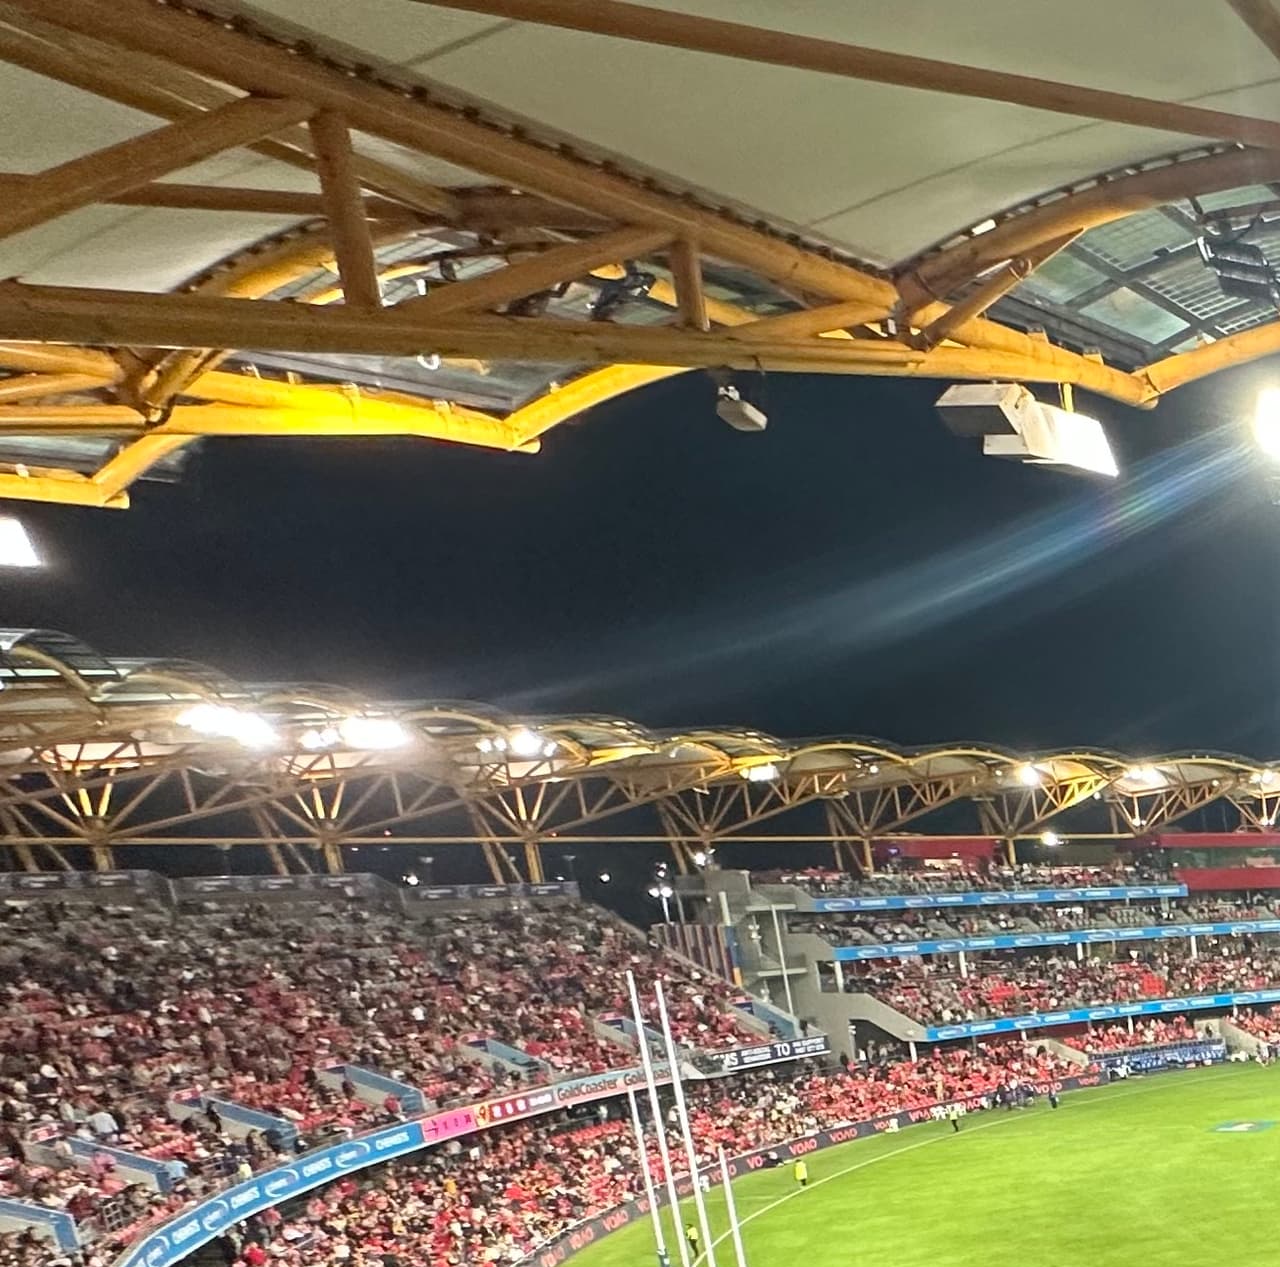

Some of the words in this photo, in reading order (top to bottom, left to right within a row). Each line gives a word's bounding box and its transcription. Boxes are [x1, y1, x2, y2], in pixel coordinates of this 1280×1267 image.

[774, 1043, 790, 1057] TO
[557, 1079, 618, 1101] GoldCoaster
[789, 1138, 818, 1156] VOAO
[709, 1165, 737, 1183] VOO
